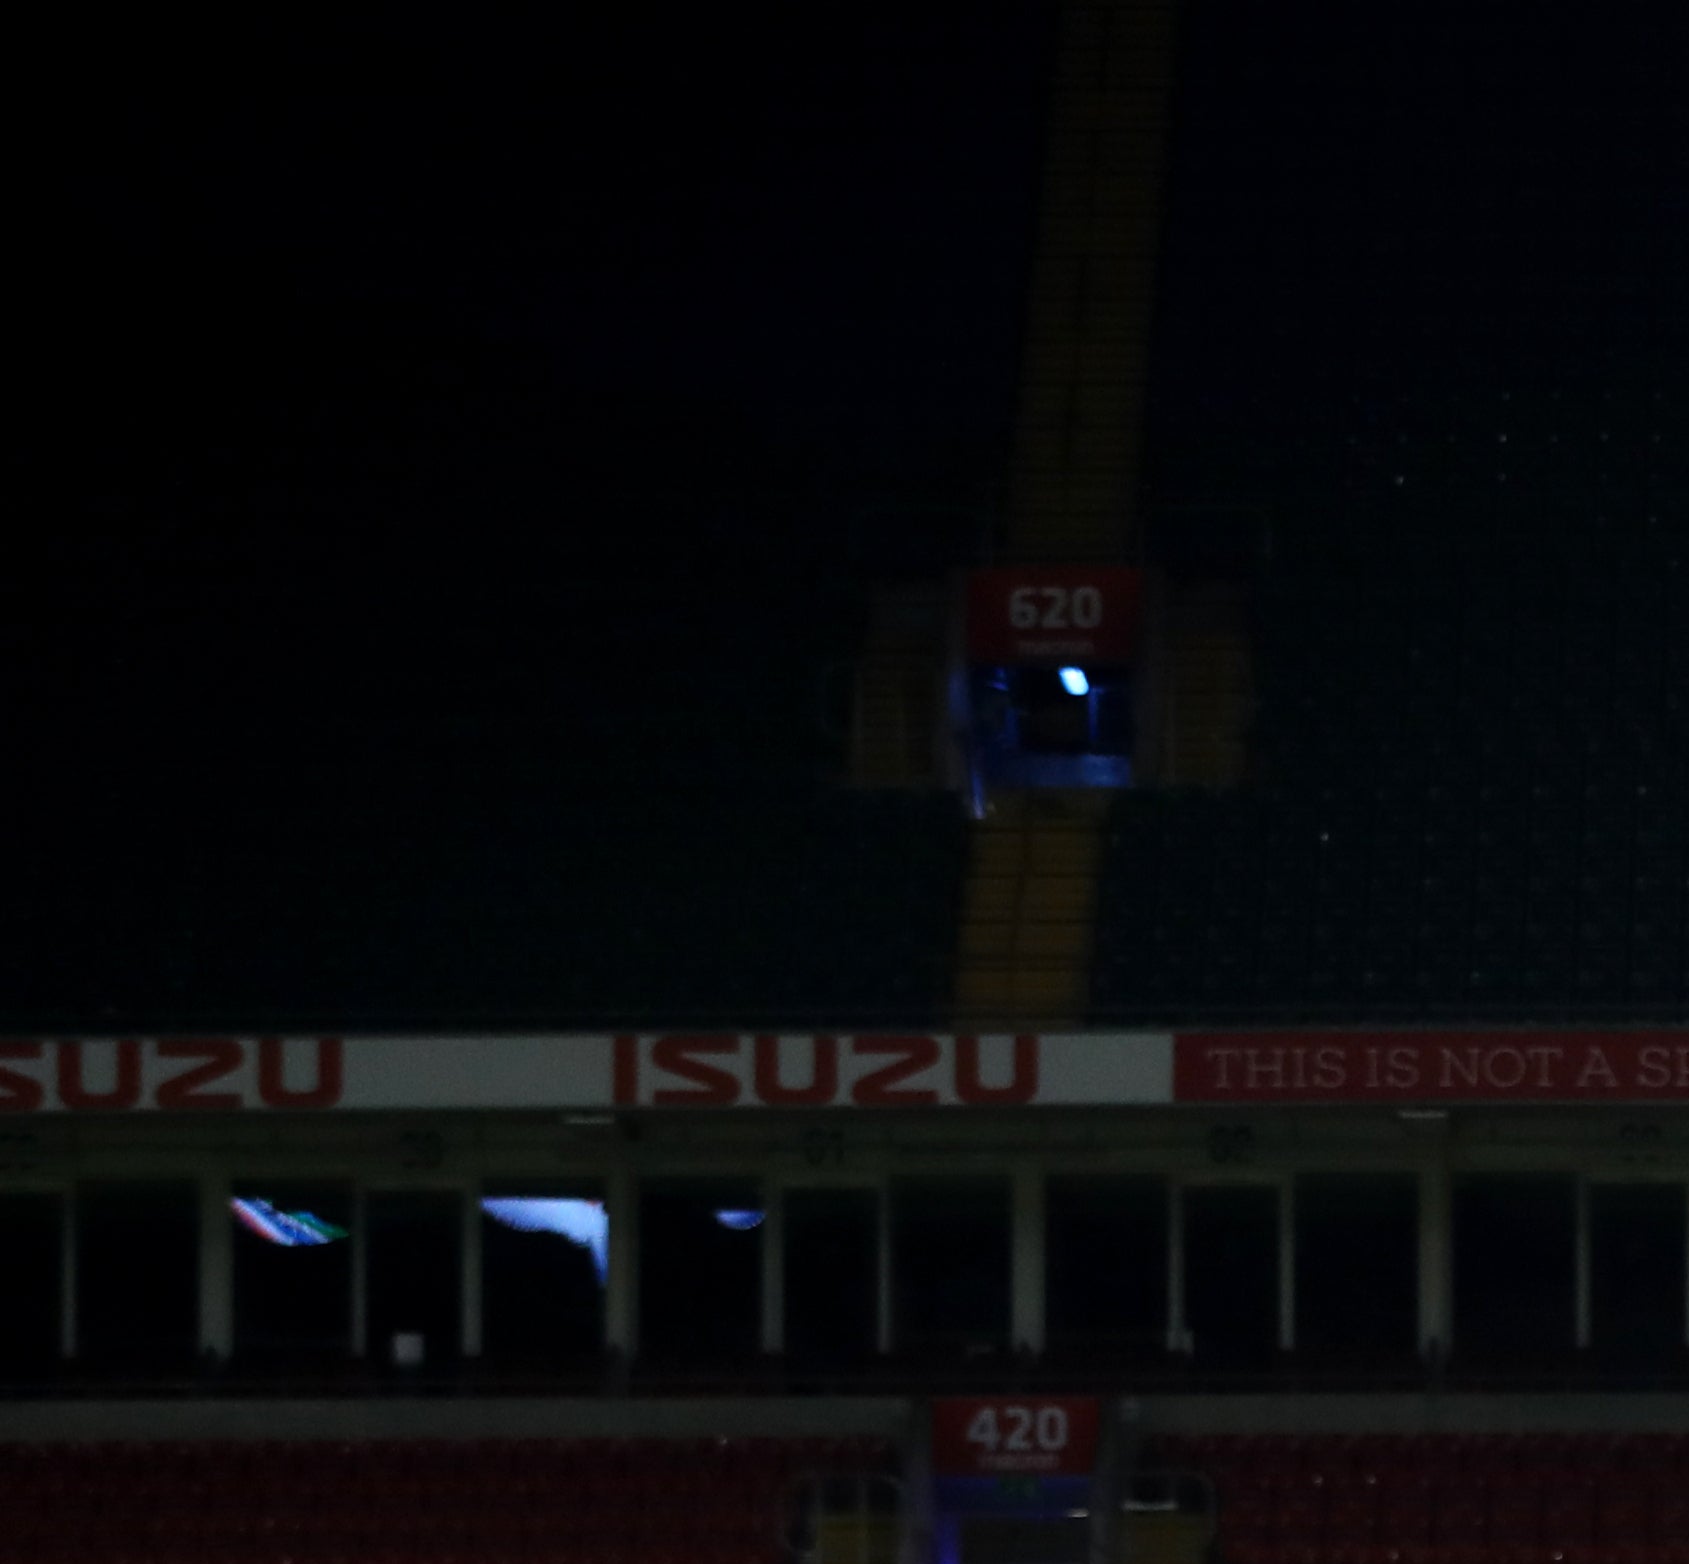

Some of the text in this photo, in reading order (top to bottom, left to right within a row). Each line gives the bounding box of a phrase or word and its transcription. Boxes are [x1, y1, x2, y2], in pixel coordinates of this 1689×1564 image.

[1008, 585, 1103, 629] 620
[613, 1034, 1039, 1107] ISUZU
[1205, 1047, 1347, 1090] THIS
[1366, 1047, 1420, 1089] IS
[1438, 1047, 1564, 1089] NOT
[1576, 1047, 1620, 1088] A
[965, 1404, 1068, 1451] 420
